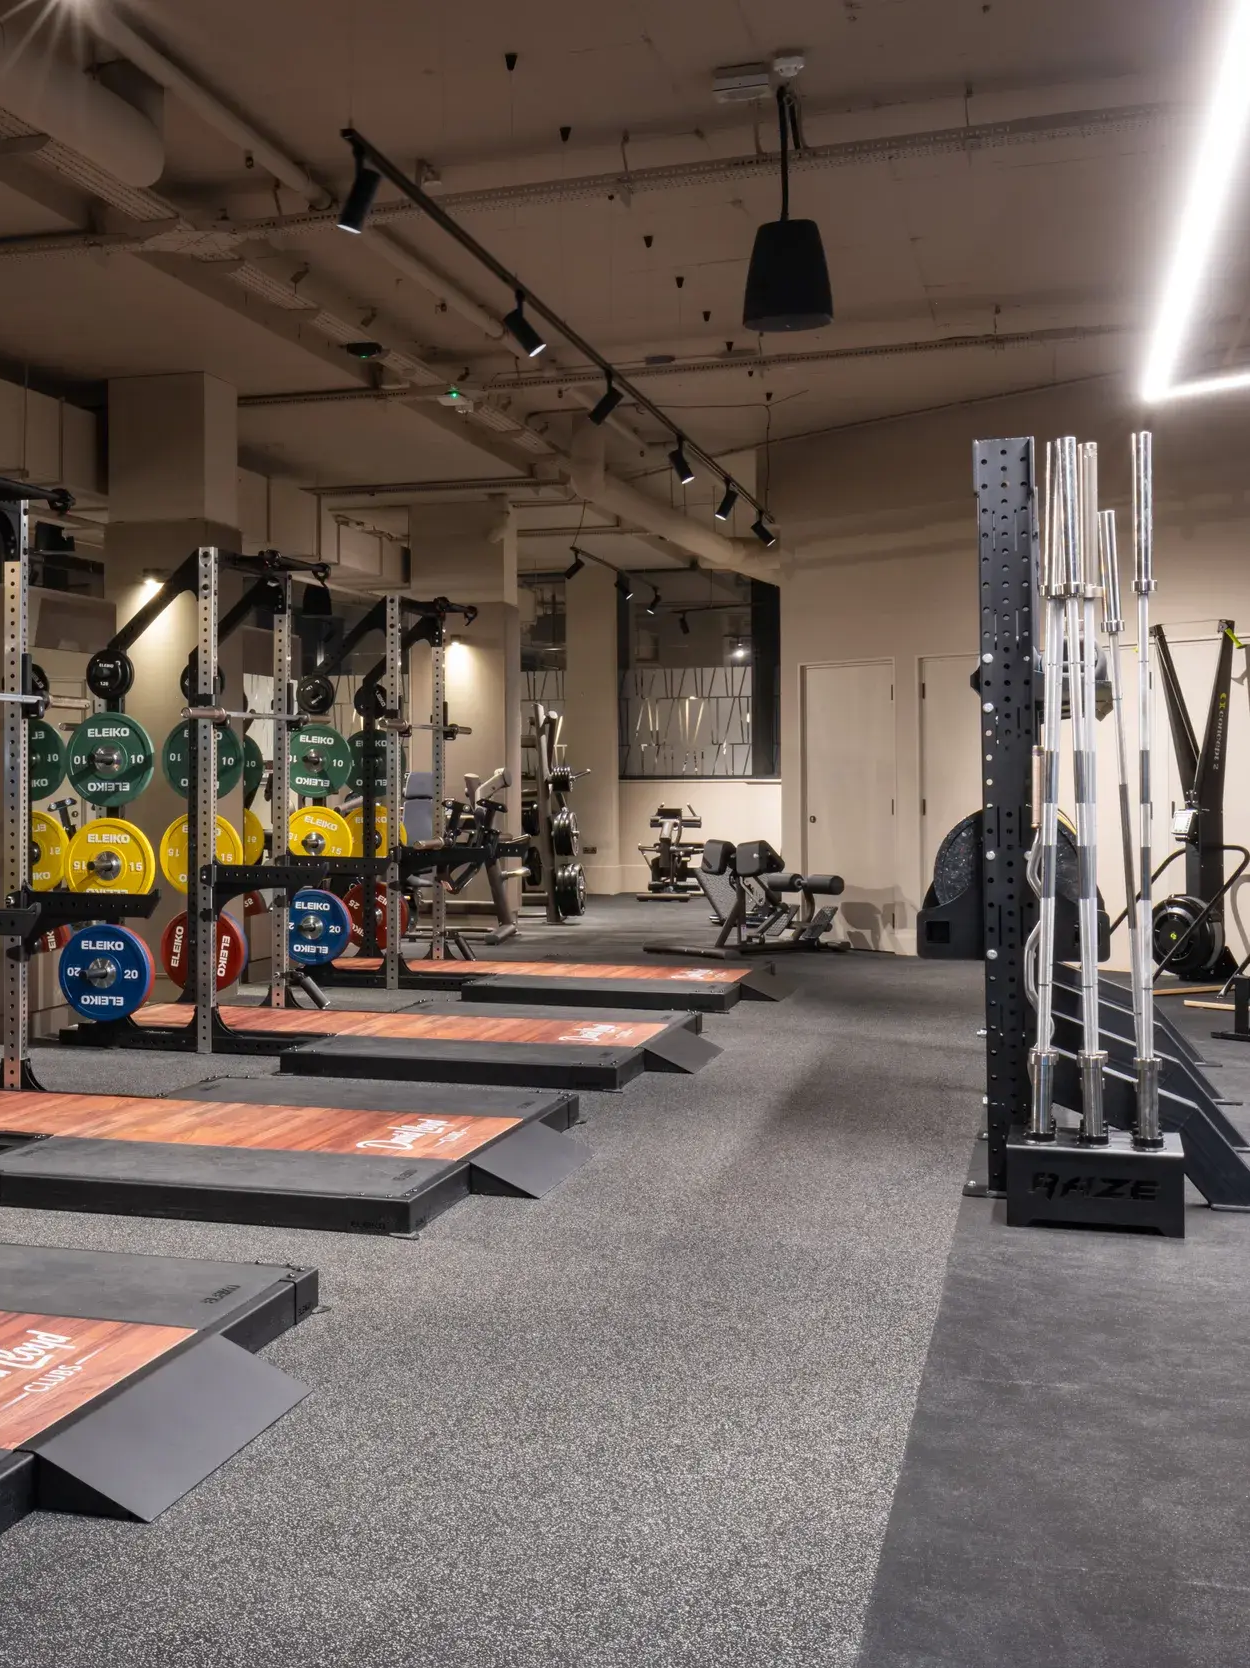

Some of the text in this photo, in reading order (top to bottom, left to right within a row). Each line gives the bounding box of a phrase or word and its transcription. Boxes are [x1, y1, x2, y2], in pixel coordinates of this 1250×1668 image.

[87, 727, 130, 738] ELEIKO
[299, 735, 335, 745] ELEIKO
[73, 755, 87, 765] 10
[130, 754, 144, 764] 10
[221, 756, 235, 766] 10
[332, 758, 344, 768] 10
[87, 782, 130, 792] ELEIKO
[295, 777, 330, 787] ELEIKO
[304, 815, 338, 831] ELEIKO
[87, 833, 130, 844] ELEIKO
[220, 853, 233, 862] 15
[129, 861, 143, 872] 15
[295, 901, 330, 911] ELEIKO
[329, 925, 341, 934] 20
[81, 940, 124, 951] ELEIKO
[170, 925, 184, 968] ELEIKO
[293, 944, 329, 954] ELEIKO
[216, 935, 231, 977] ELEIKO
[124, 969, 138, 979] 20
[81, 995, 124, 1006] ELEIKO
[23, 1365, 83, 1393] CLUBS
